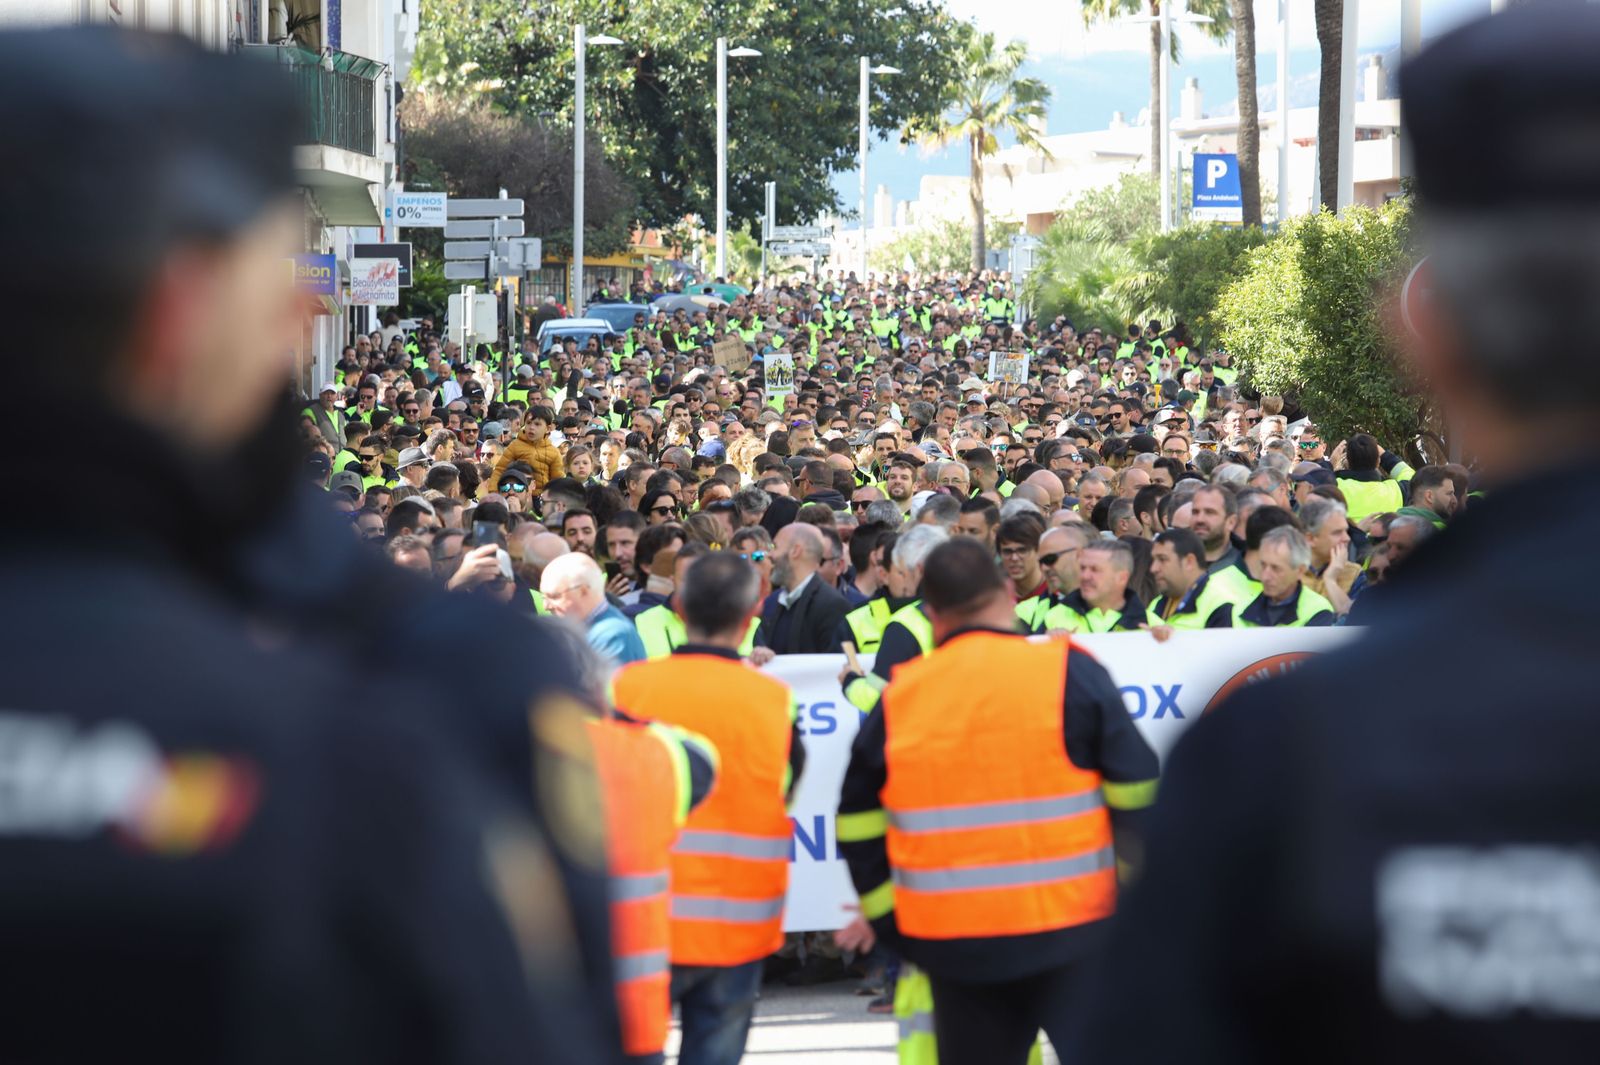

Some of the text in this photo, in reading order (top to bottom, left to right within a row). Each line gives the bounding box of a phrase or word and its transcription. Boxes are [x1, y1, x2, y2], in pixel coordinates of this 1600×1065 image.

[1207, 159, 1228, 188] P
[397, 206, 421, 219] 0%
[352, 277, 376, 289] Beauty
